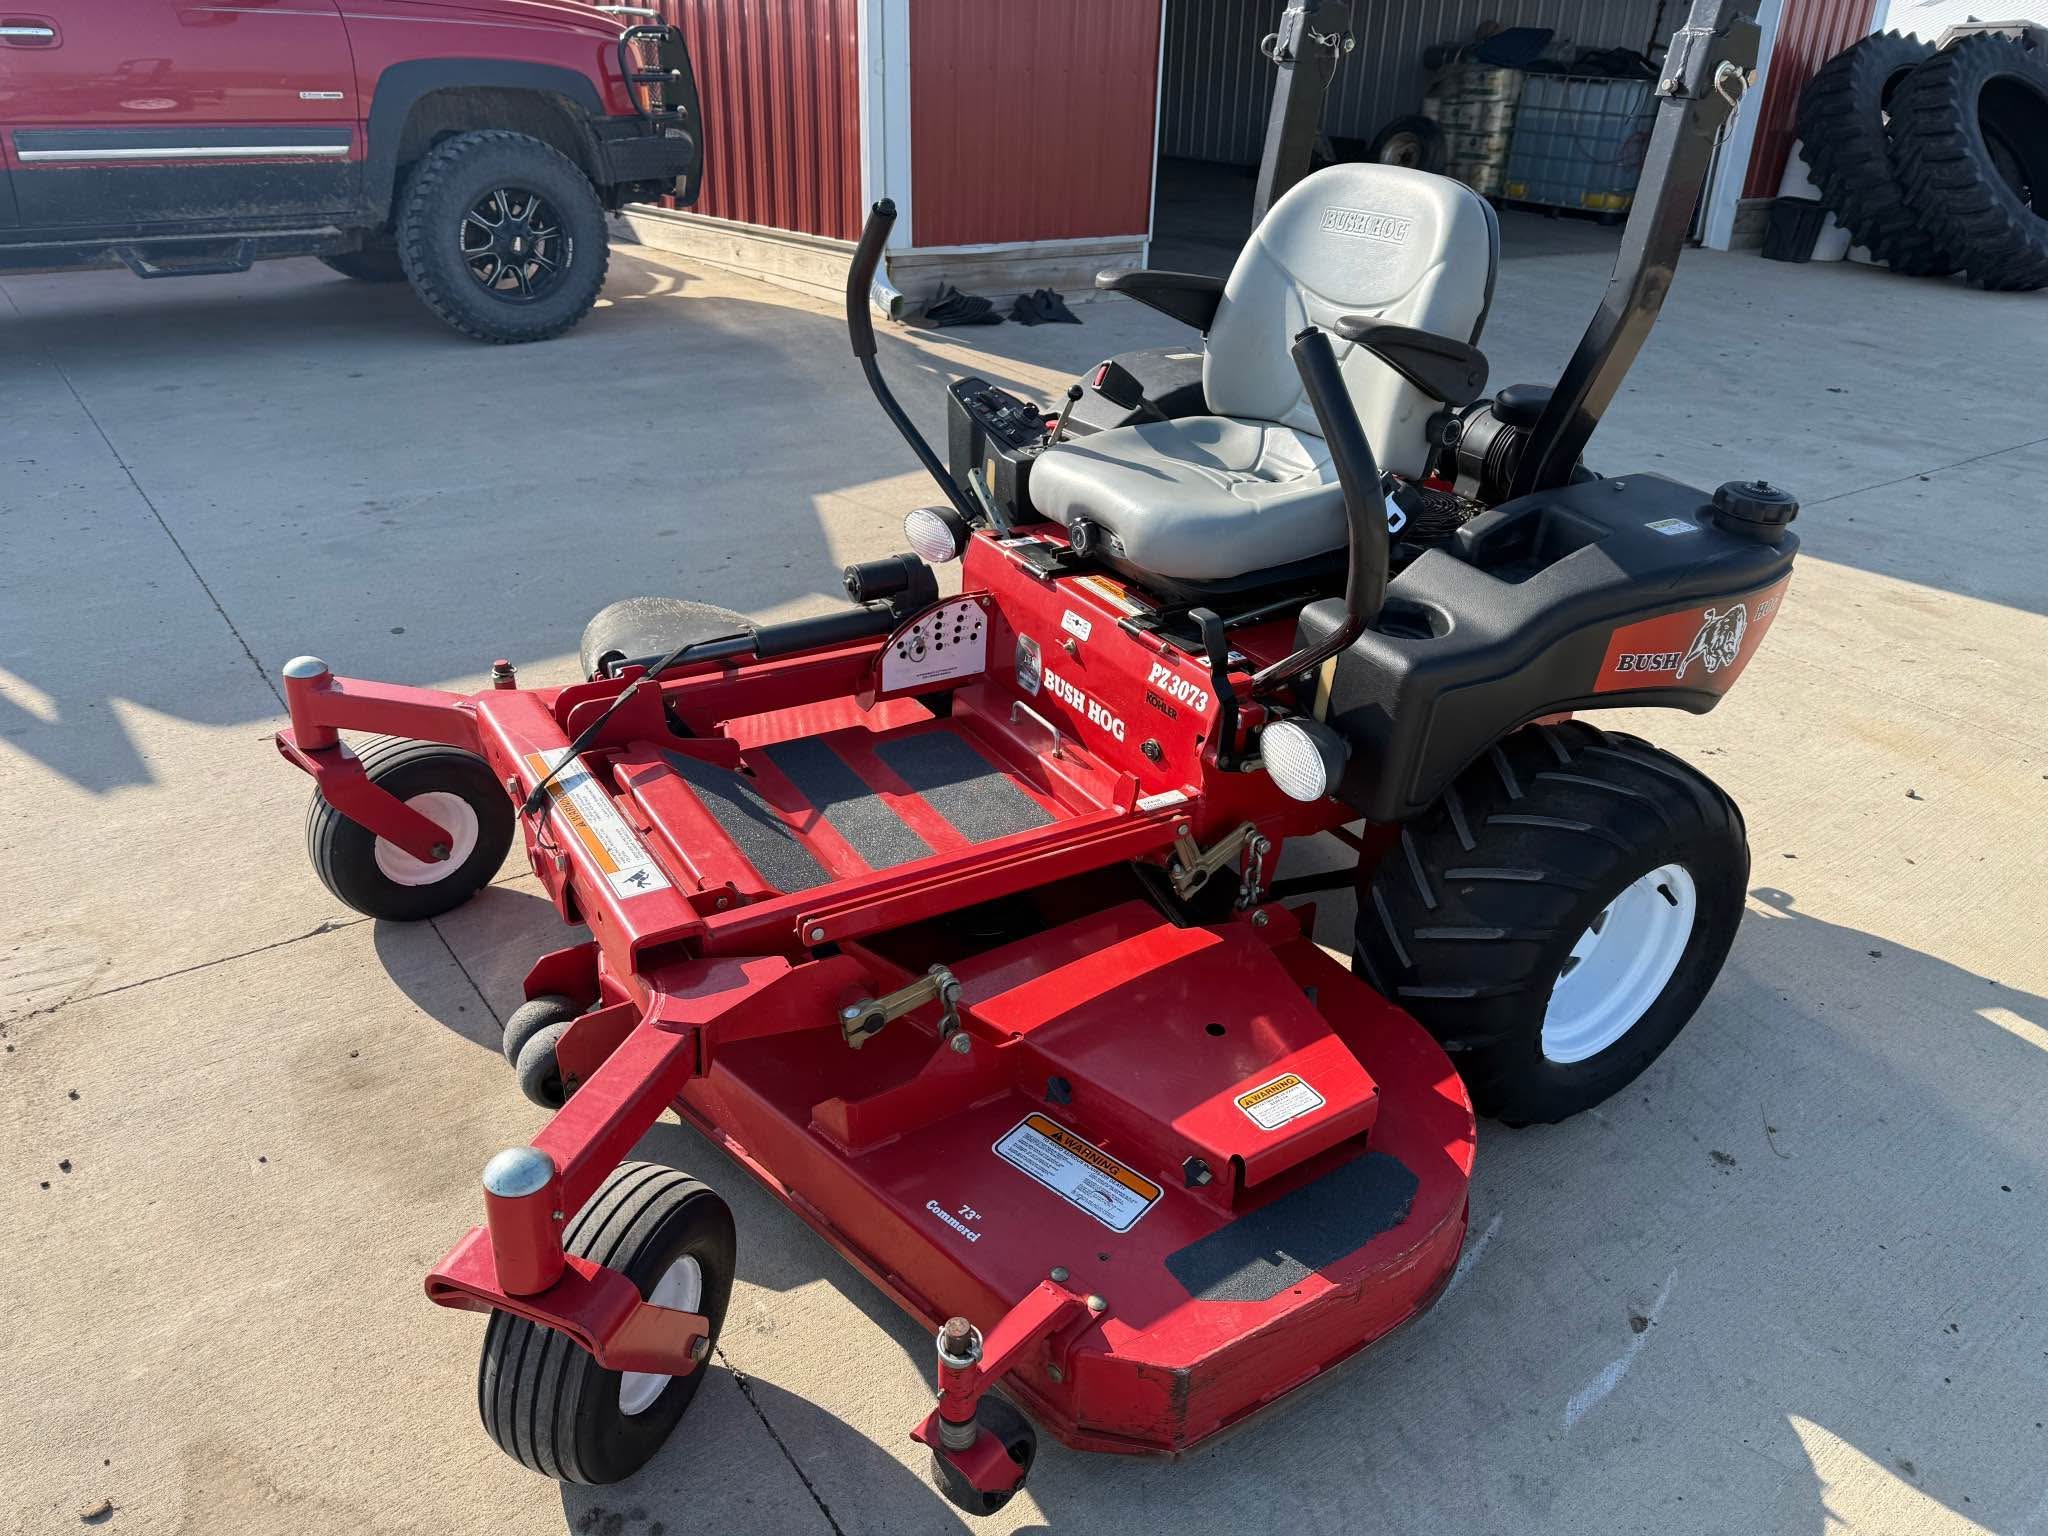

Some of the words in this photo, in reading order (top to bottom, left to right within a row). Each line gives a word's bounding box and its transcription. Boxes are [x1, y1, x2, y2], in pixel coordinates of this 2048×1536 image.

[1322, 209, 1369, 233] BUSH
[1369, 216, 1410, 241] HOG
[1615, 651, 1682, 672] BUSH
[1147, 661, 1209, 712] PZ3073
[1043, 667, 1085, 714] BUSH
[1087, 698, 1125, 743] HOG
[1146, 689, 1177, 720] KOHLER
[1252, 1078, 1295, 1101] WARNING
[1065, 1136, 1120, 1176] WARNING
[958, 1204, 982, 1220] 73"
